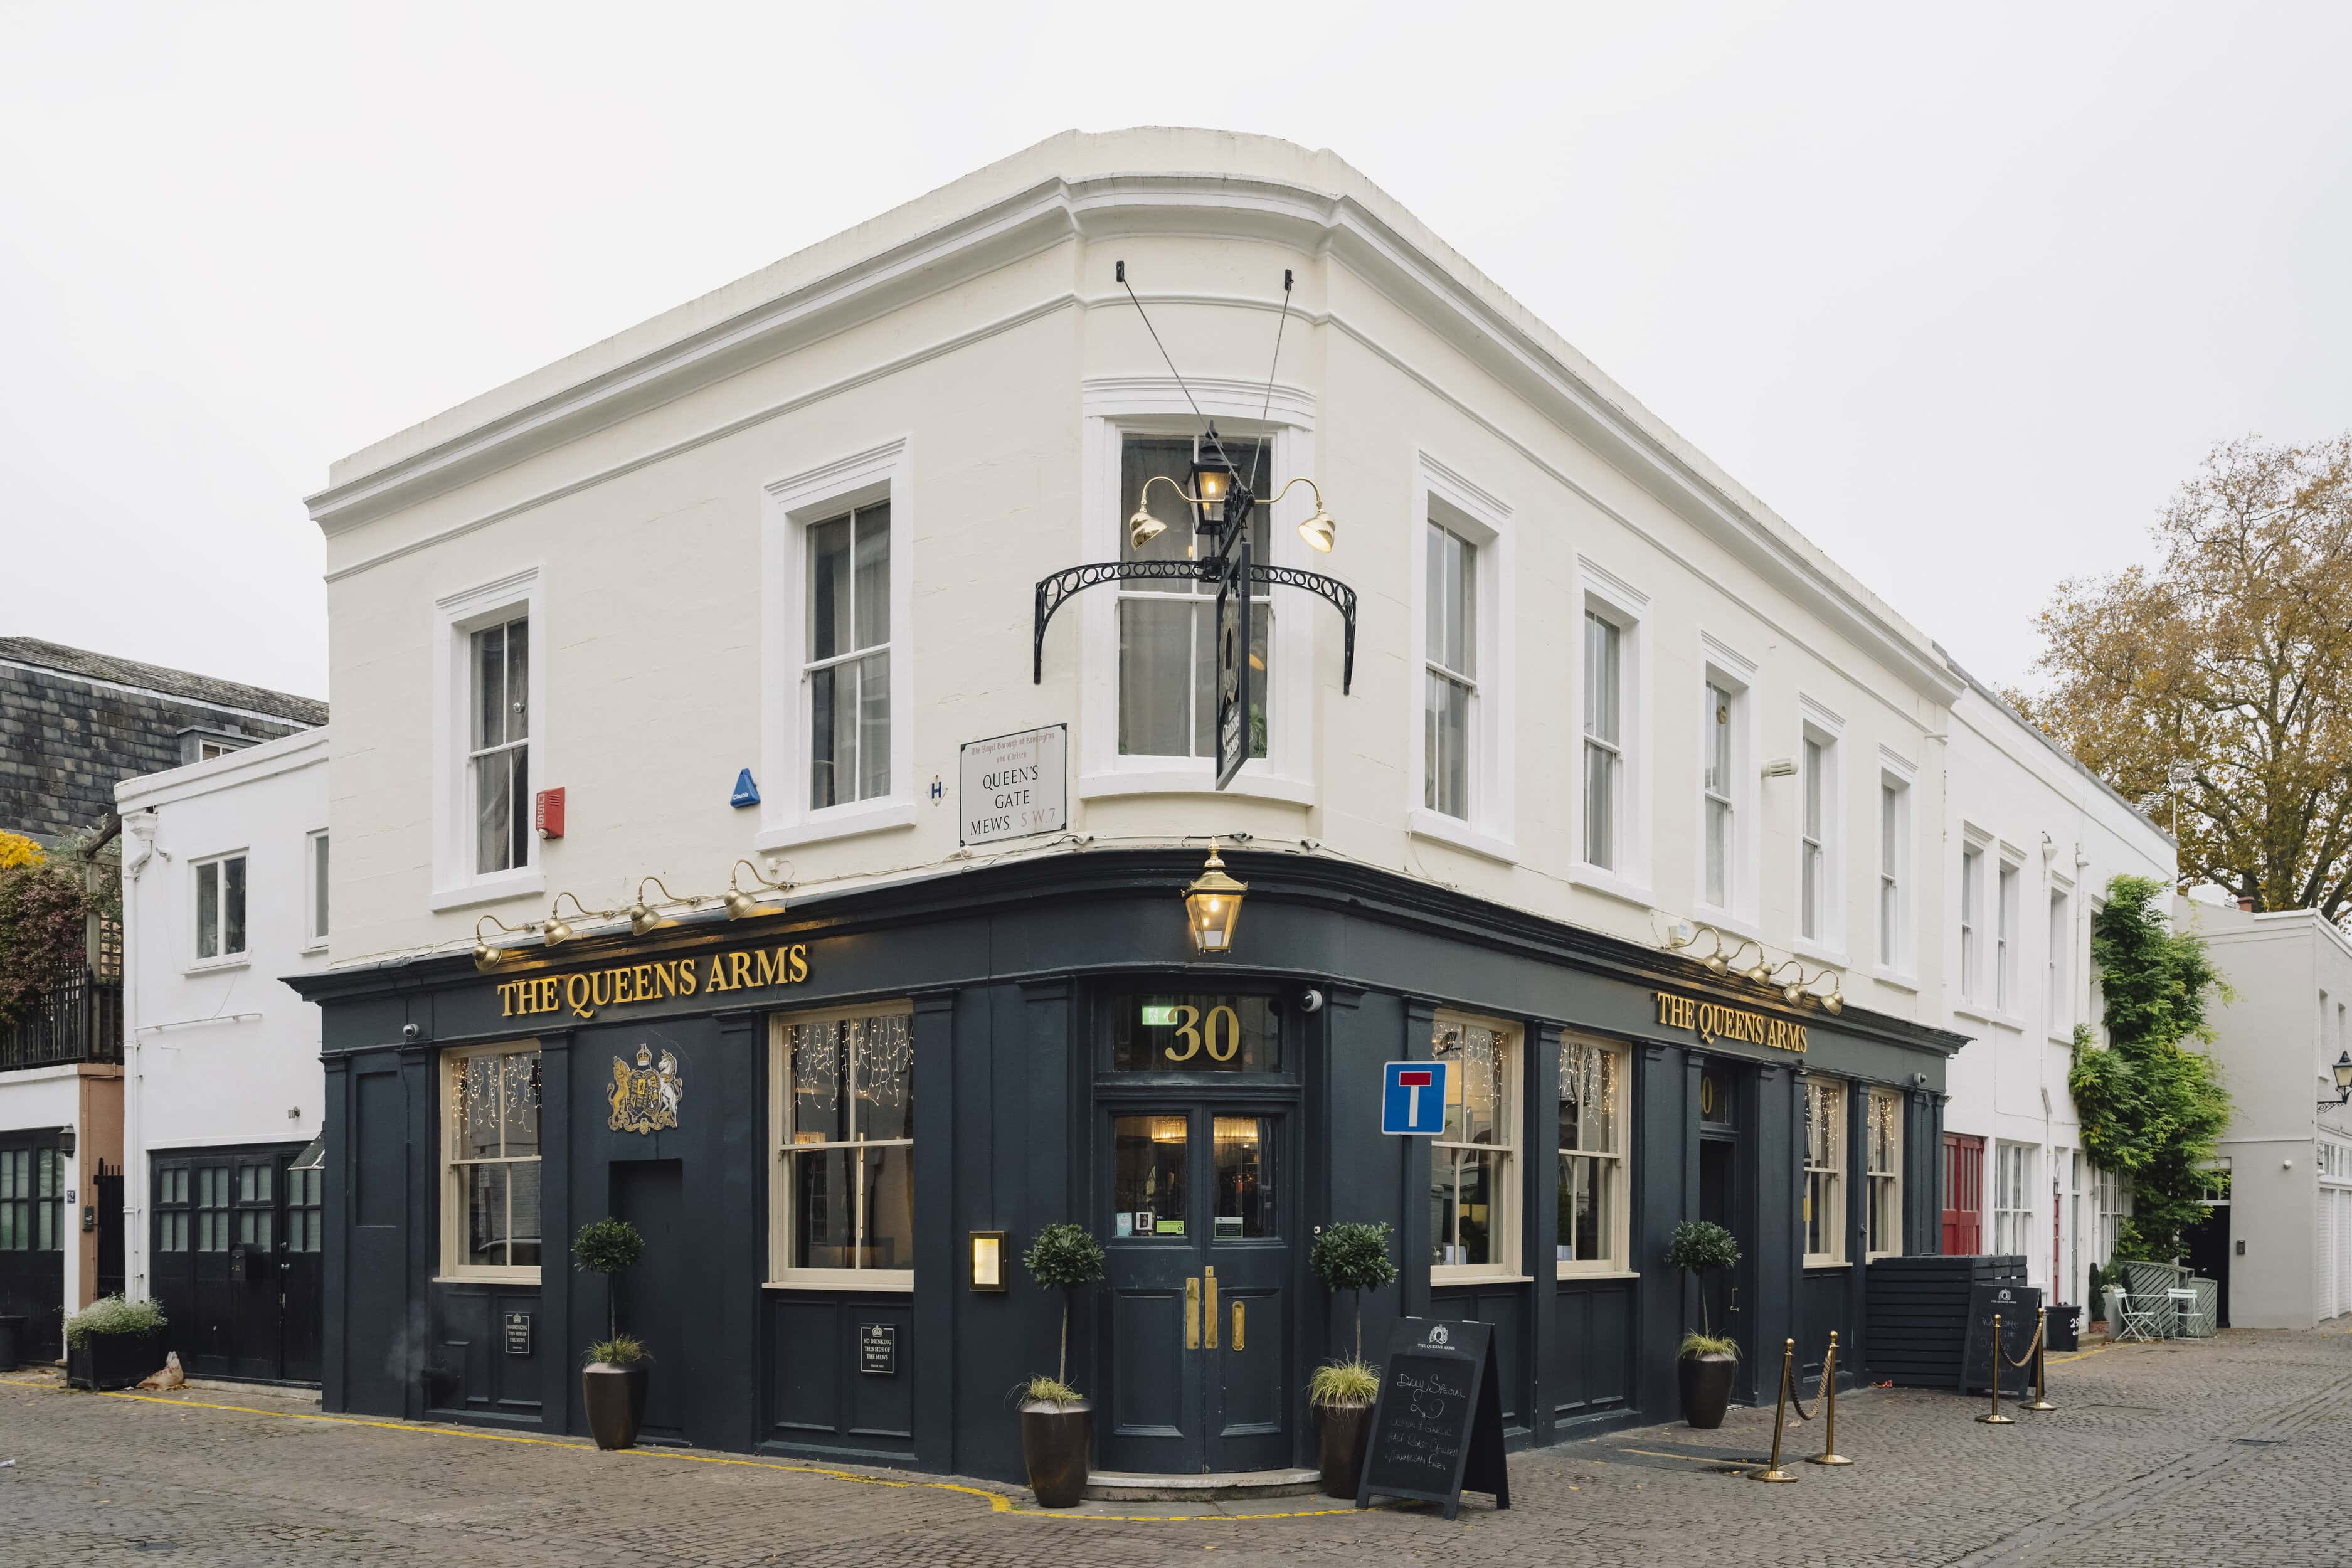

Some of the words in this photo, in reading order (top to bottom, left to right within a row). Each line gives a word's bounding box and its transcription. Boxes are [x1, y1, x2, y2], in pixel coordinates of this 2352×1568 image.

[972, 747, 980, 755] The
[982, 744, 996, 753] Royal
[997, 739, 1017, 750] Borough
[1026, 733, 1054, 743] Kensington
[1007, 751, 1027, 761] Chelsea
[983, 765, 1039, 790] QUEEN'S
[733, 792, 748, 800] Chubb
[931, 781, 942, 799] H
[995, 790, 1030, 809] GATE
[497, 977, 559, 1017] THE
[566, 959, 696, 1019] QUEENS
[705, 944, 808, 993] ARMS
[1165, 1005, 1239, 1061] 30
[1657, 992, 1695, 1030] THE
[1699, 1003, 1764, 1044] QUEENS
[1766, 1018, 1808, 1054] ARMS
[1429, 1374, 1465, 1398] SPECIAL
